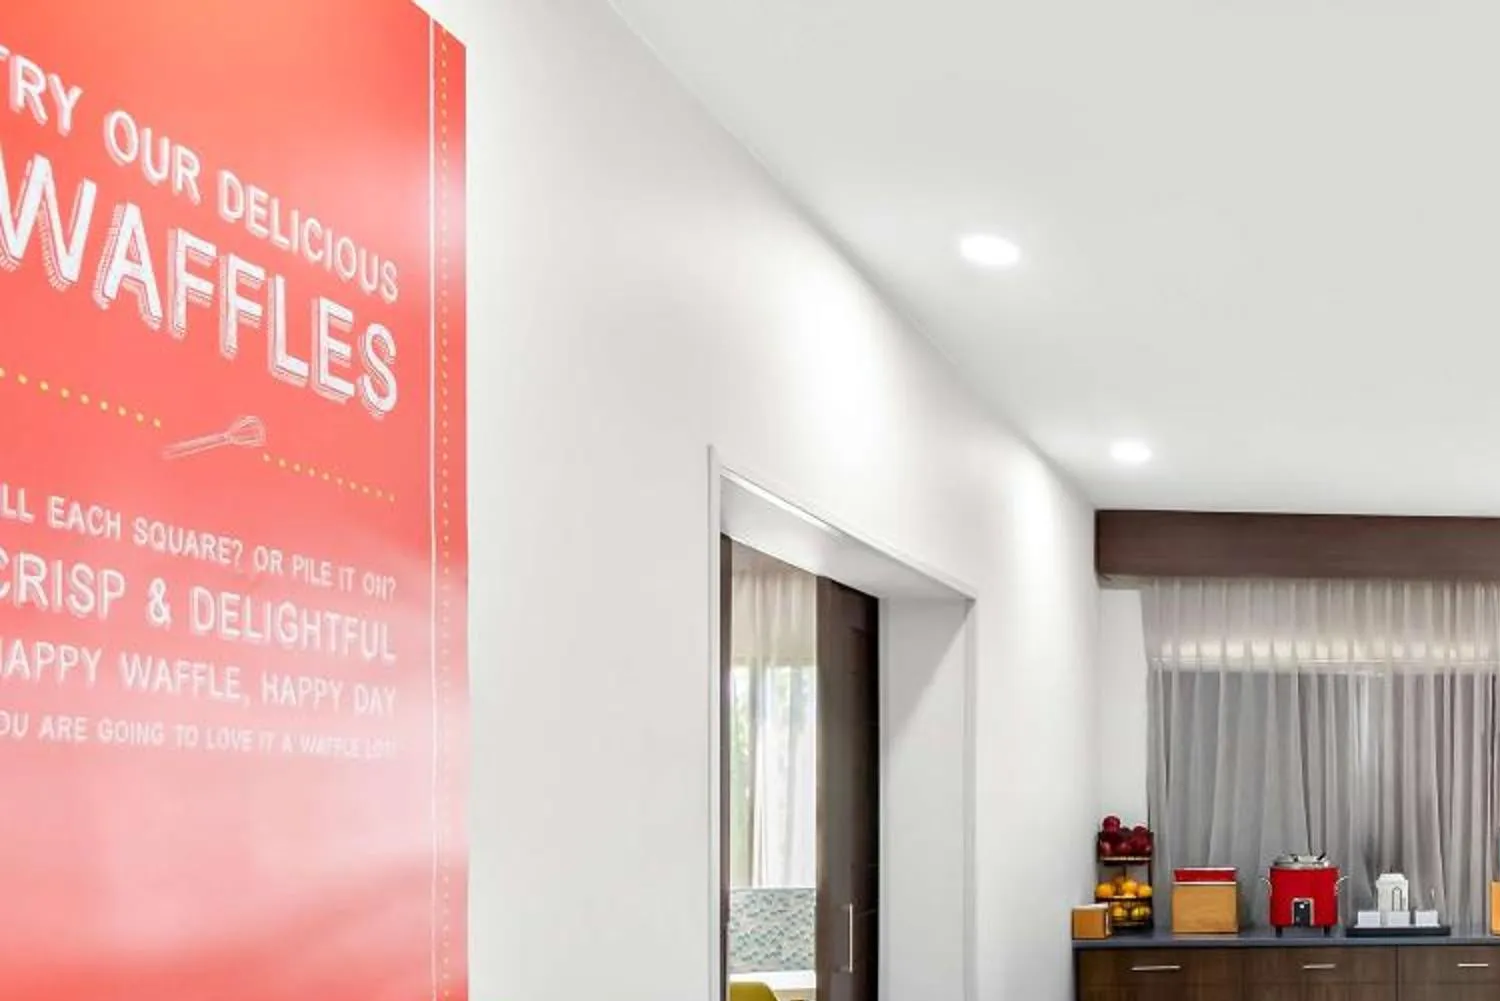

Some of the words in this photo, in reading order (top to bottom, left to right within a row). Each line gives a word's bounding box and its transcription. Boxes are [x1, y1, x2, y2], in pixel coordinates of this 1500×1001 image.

[0, 44, 83, 136] RY
[104, 109, 201, 206] OUR
[218, 168, 399, 303] DELICIOUS
[0, 142, 398, 418] WAFFLES
[48, 495, 121, 541] EACH
[132, 516, 243, 570] SQUARE?
[254, 545, 284, 577] OR
[292, 554, 333, 587] PILE
[339, 566, 356, 592] IT
[147, 577, 171, 630] &
[190, 585, 397, 665] DELIGHTFUL
[0, 637, 102, 687] APPY
[119, 651, 250, 708] WAFFLE,
[261, 671, 343, 713] HAPPY
[353, 683, 396, 717] DAY
[0, 709, 29, 739] OU
[39, 714, 88, 742] ARE
[97, 717, 164, 747] GOING
[173, 723, 199, 749] TO
[206, 726, 253, 753] LOVE
